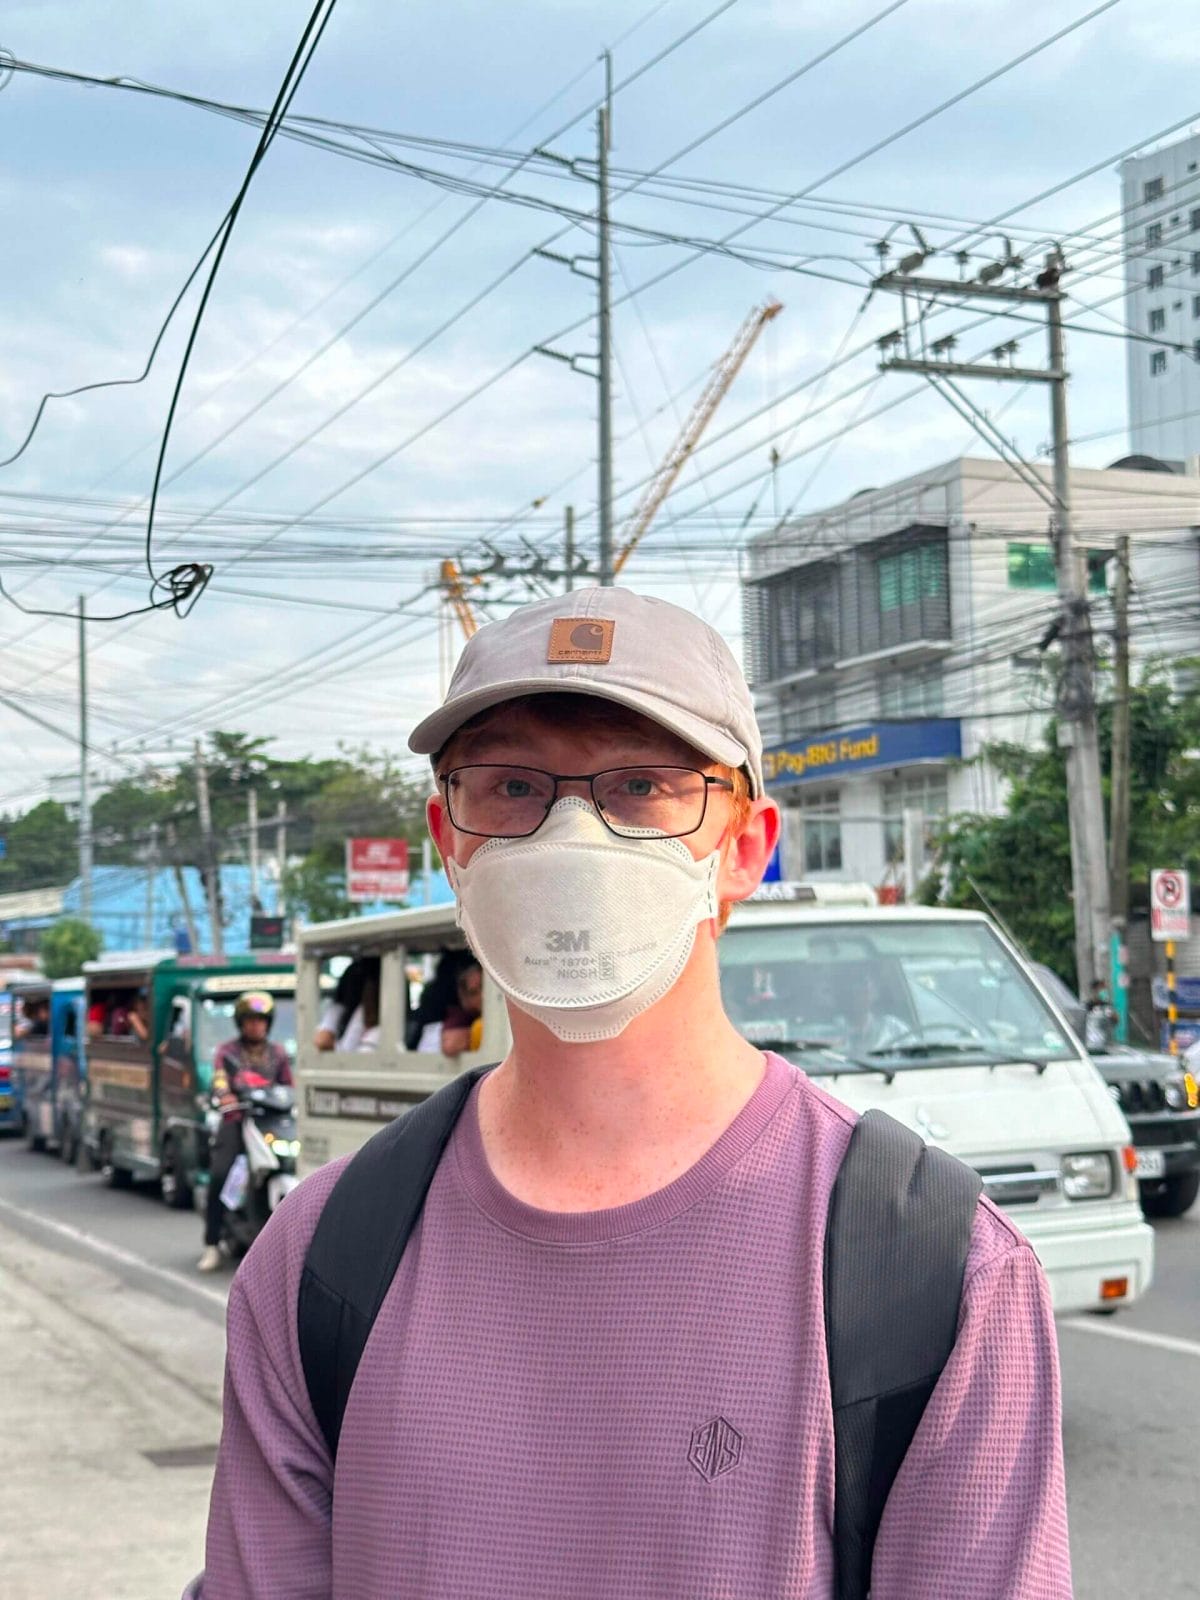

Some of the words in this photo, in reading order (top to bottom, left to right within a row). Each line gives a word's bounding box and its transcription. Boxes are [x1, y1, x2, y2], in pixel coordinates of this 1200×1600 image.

[840, 734, 879, 761] Fund
[545, 929, 589, 952] 3M
[560, 957, 596, 967] 1870+
[557, 968, 597, 979] NIOSH
